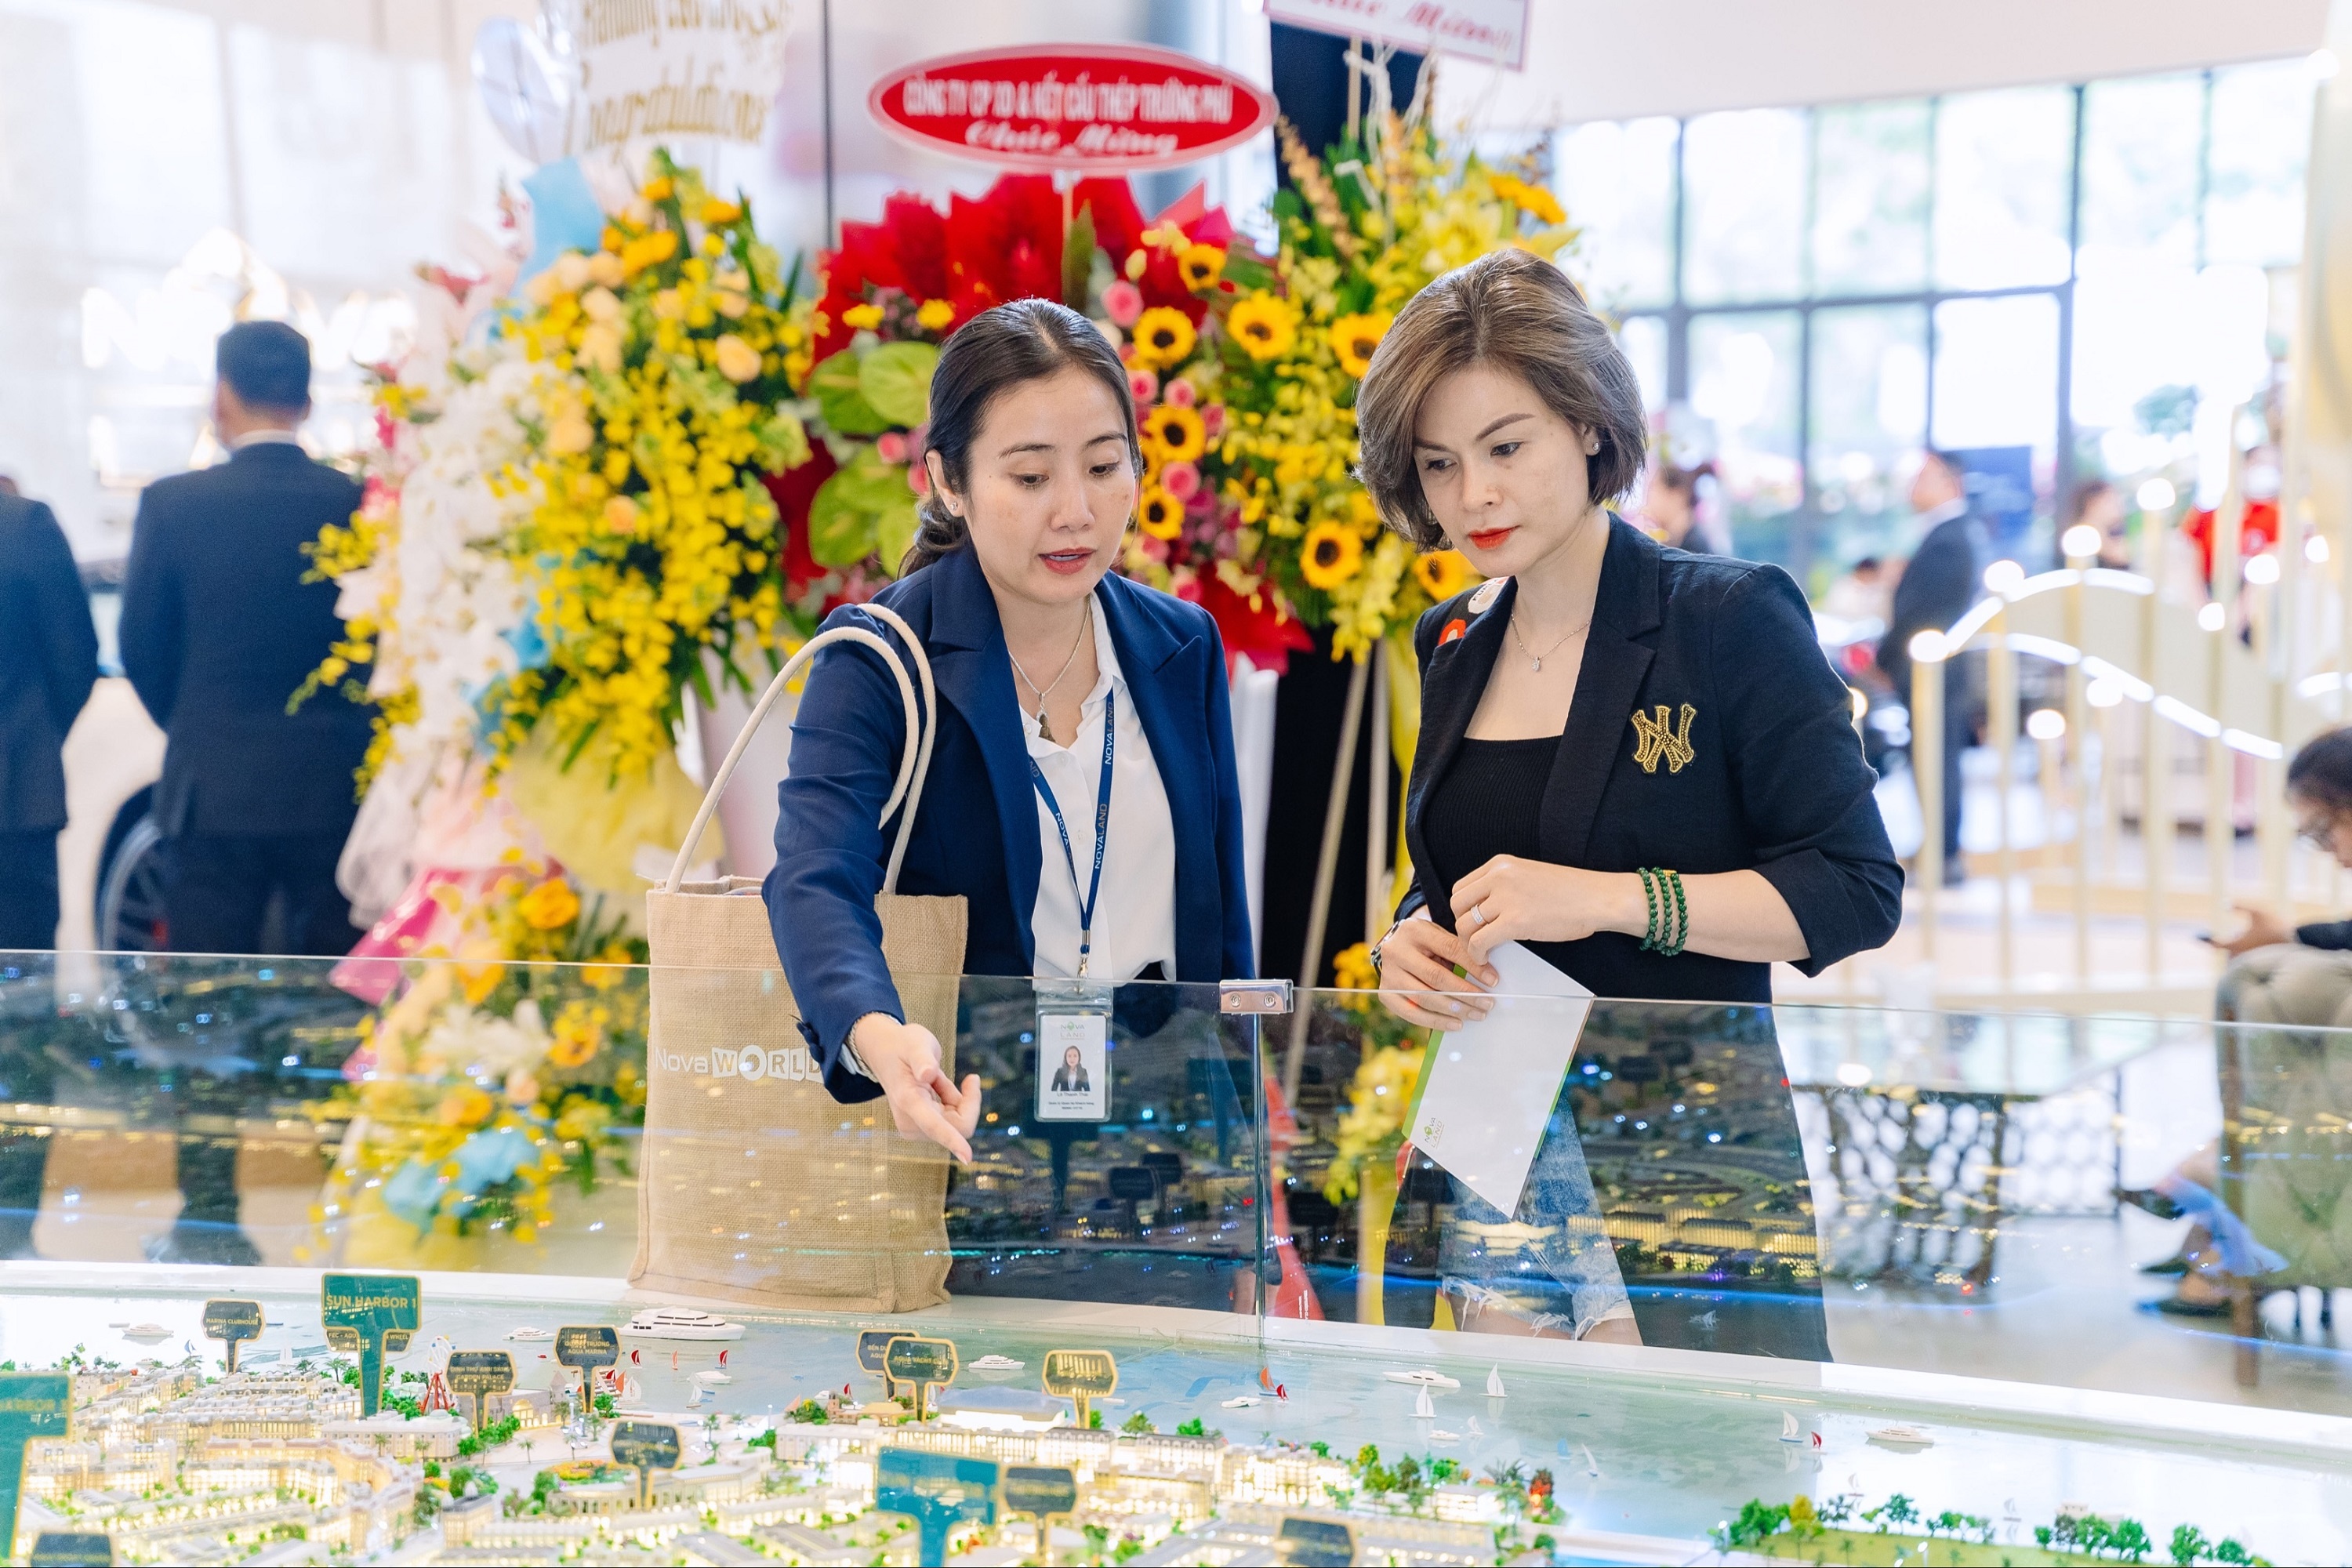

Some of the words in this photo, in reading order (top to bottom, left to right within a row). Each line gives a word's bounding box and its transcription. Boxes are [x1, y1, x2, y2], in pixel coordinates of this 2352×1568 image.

[1094, 803, 1107, 869] NOVALAND
[326, 1295, 351, 1306] SUN
[354, 1296, 408, 1308] HARBOR
